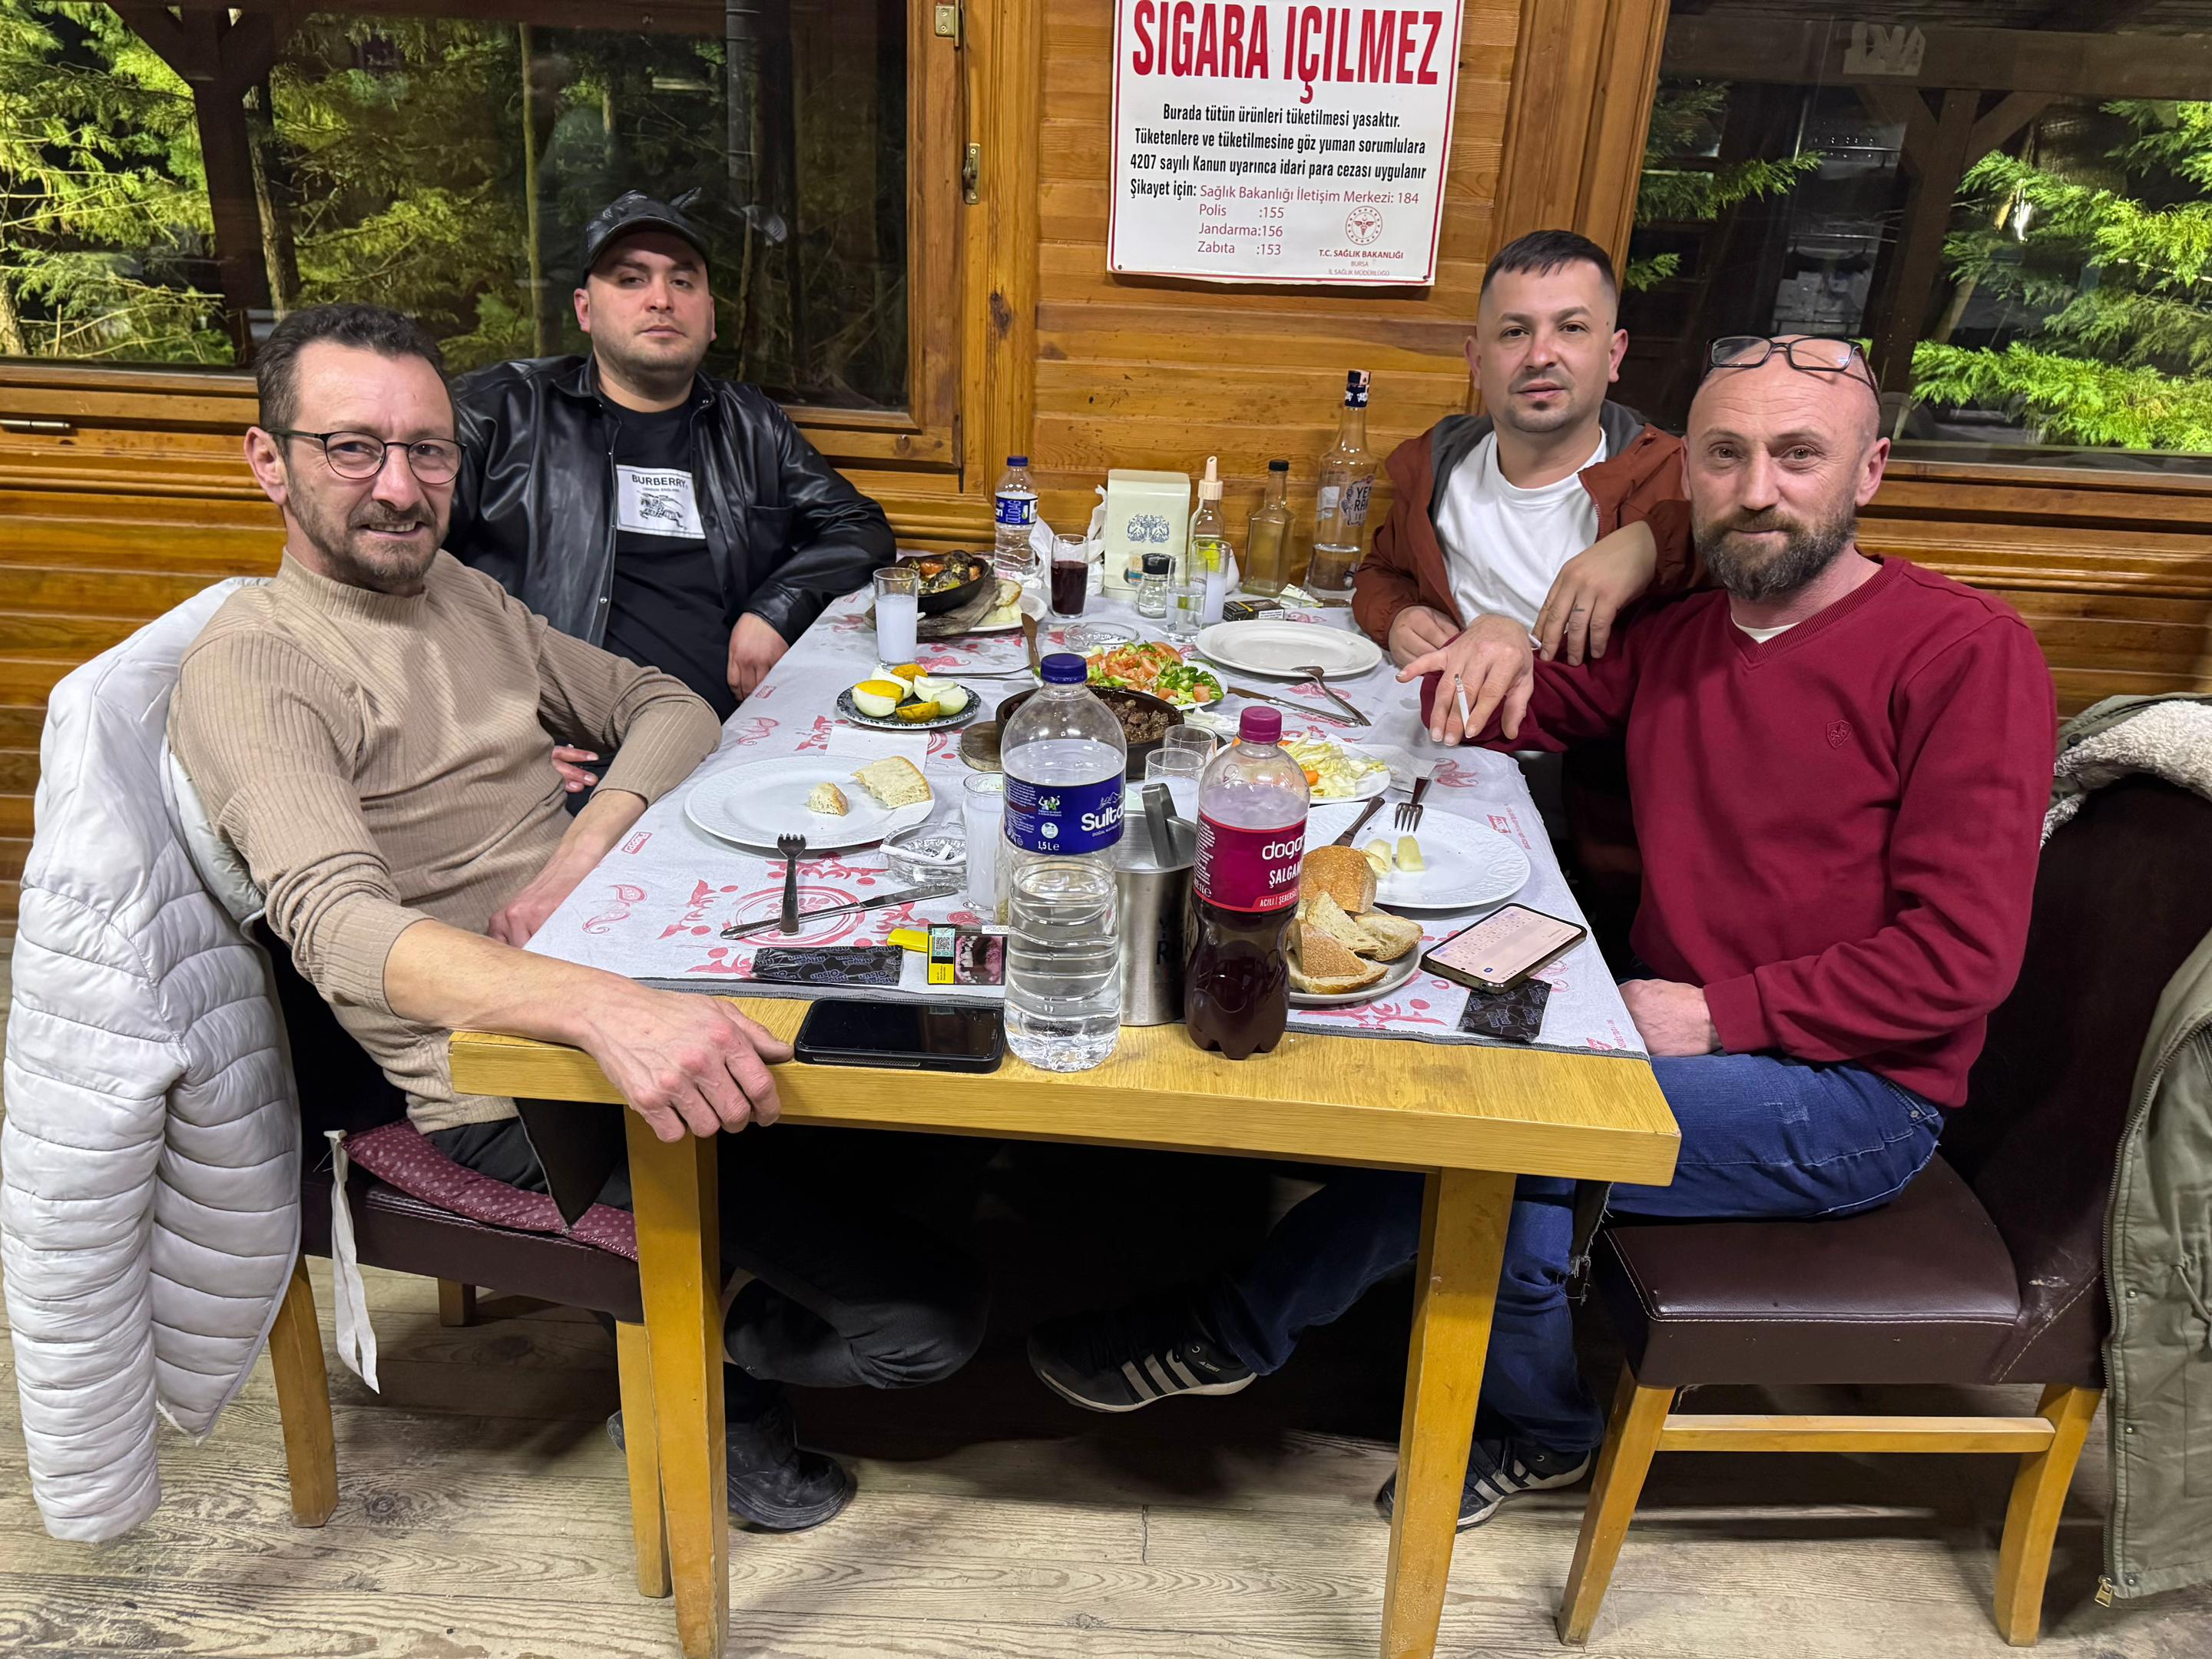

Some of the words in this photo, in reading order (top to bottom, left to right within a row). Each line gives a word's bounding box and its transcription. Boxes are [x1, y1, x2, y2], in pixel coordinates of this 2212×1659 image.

[1164, 104, 1201, 121] Burada
[1206, 105, 1235, 122] tütün
[1239, 106, 1283, 124] ürünleri
[1286, 108, 1349, 126] tüketilmesi
[1353, 111, 1400, 130] yasaktır.
[1135, 127, 1199, 146] Tüketenlere
[1202, 134, 1215, 147] ve
[1218, 131, 1294, 150] tüketilmesine
[1297, 134, 1316, 154] göz
[1319, 138, 1356, 154] yuman
[1359, 137, 1426, 154] sorumlulara
[1131, 154, 1157, 170] 4207
[1160, 155, 1190, 174] sayılı
[1193, 155, 1227, 172] Kanun
[1230, 160, 1277, 176] uyarınca
[1280, 159, 1306, 175] idari
[1309, 163, 1333, 179] para
[1337, 164, 1372, 177] cezası
[1375, 163, 1427, 182] uygulanır
[1130, 178, 1170, 199] Şikayet
[1173, 180, 1197, 200] için:
[1200, 184, 1236, 200] Sağlık
[1239, 186, 1293, 203] Bakanlığı
[1296, 186, 1340, 204] İletişim
[1343, 190, 1394, 204] Merkezi:
[1398, 192, 1419, 204] 184
[1199, 204, 1227, 217] Polis
[1197, 240, 1235, 253] Zabıta
[1333, 249, 1360, 258] SAĞLIK
[1362, 250, 1404, 259] BAKANLIĞI
[632, 474, 686, 488] BURBERRY
